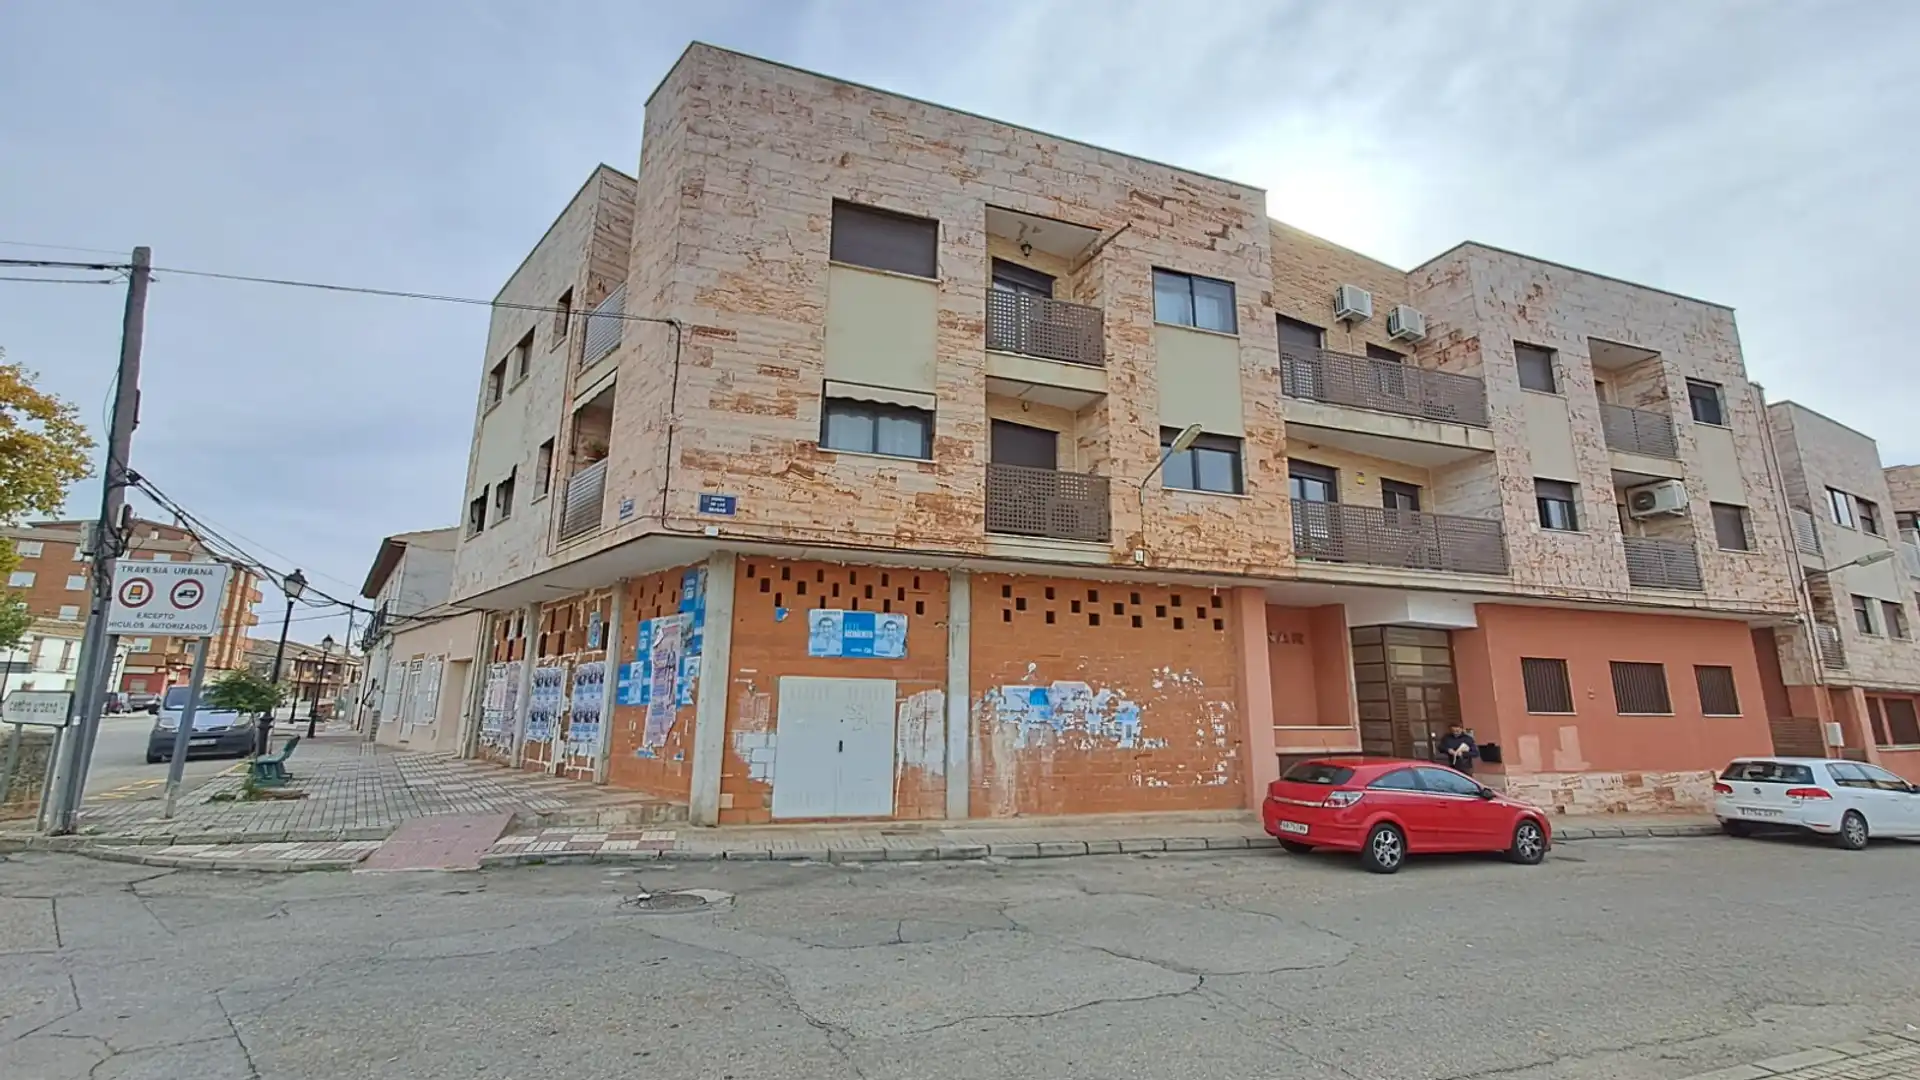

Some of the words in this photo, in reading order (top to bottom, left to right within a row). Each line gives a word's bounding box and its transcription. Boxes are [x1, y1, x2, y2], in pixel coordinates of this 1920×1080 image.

[121, 565, 168, 574] TRAVESIA
[174, 567, 213, 576] URBANA
[136, 612, 176, 620] EXCEPTO
[109, 621, 145, 629] HICULOS
[148, 621, 208, 630] AUTORIZADOS
